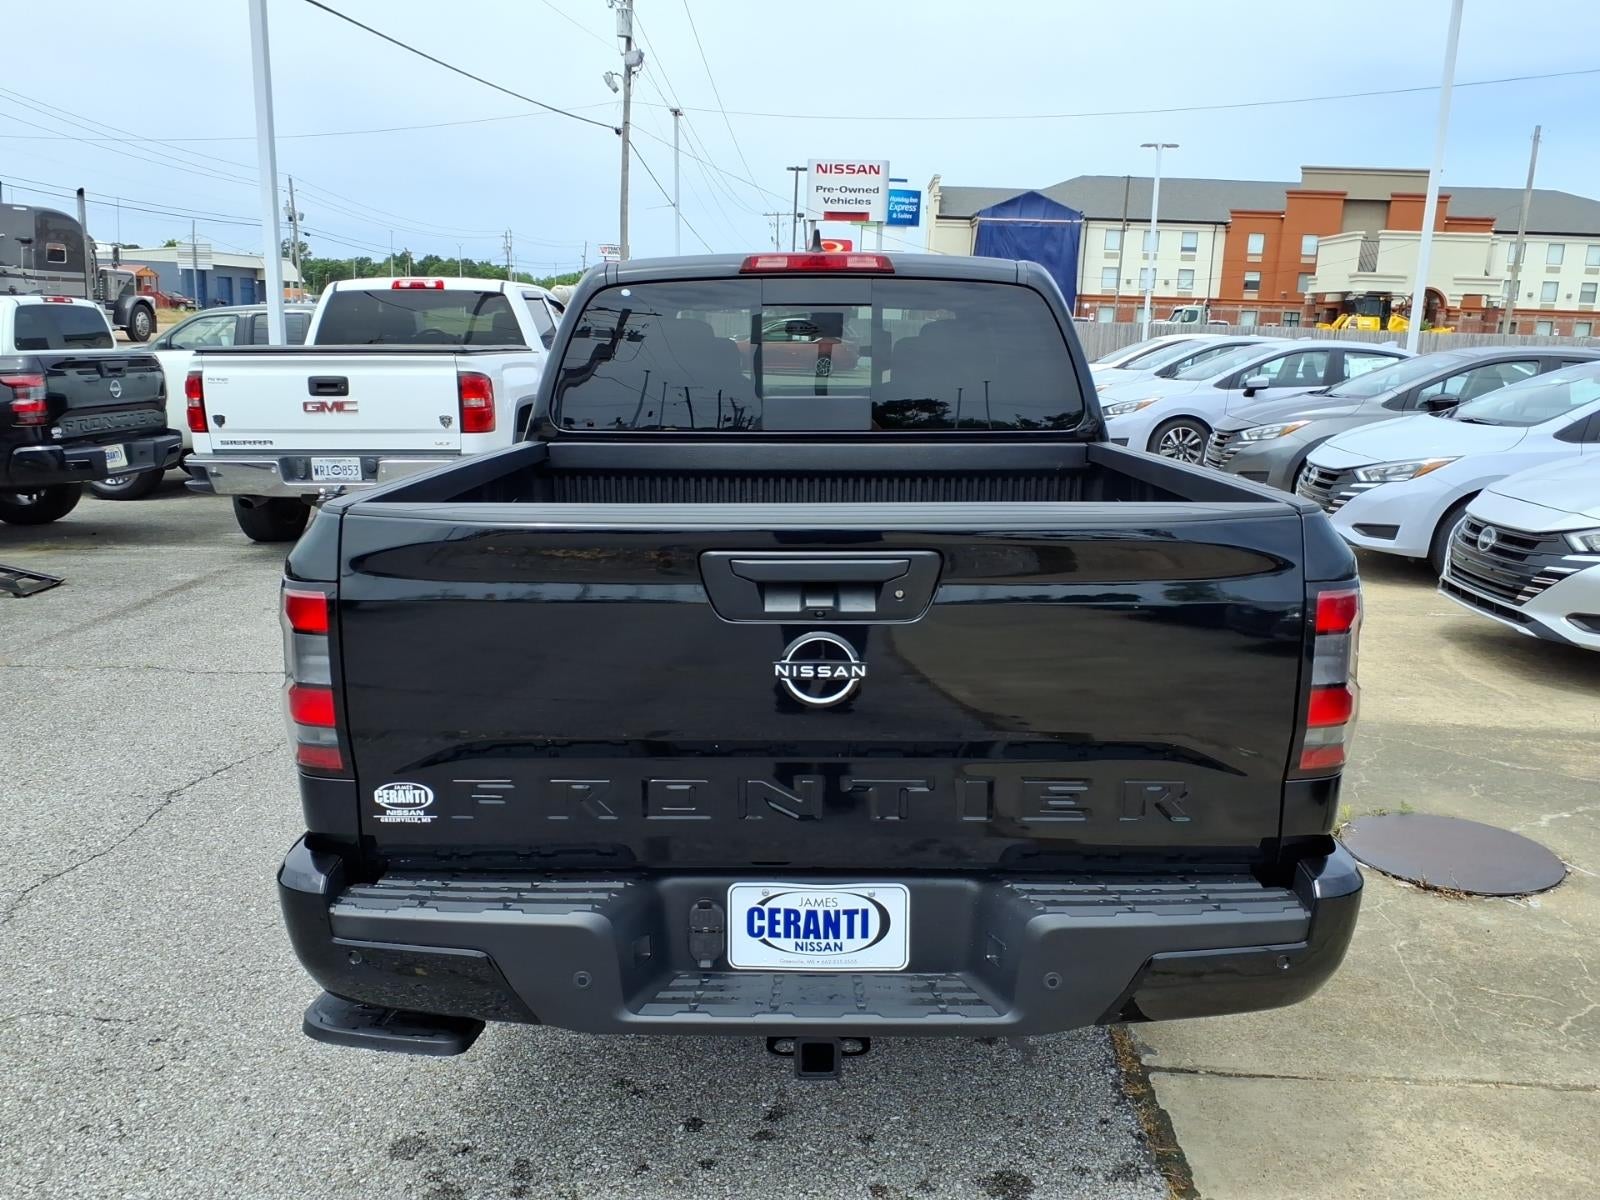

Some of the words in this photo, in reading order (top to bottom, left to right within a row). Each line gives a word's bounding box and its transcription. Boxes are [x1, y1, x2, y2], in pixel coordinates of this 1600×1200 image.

[816, 164, 880, 175] NISSAN
[816, 185, 880, 194] Pre-Owned
[823, 197, 872, 206] Vehicles
[889, 202, 918, 212] Express
[303, 401, 358, 413] GMC
[775, 664, 865, 677] NISSAN
[374, 790, 425, 803] CERANTI
[451, 777, 1191, 822] FRONTIER
[799, 897, 838, 907] JAMES
[747, 906, 868, 939] CERANTI
[795, 941, 843, 952] NISSAN
